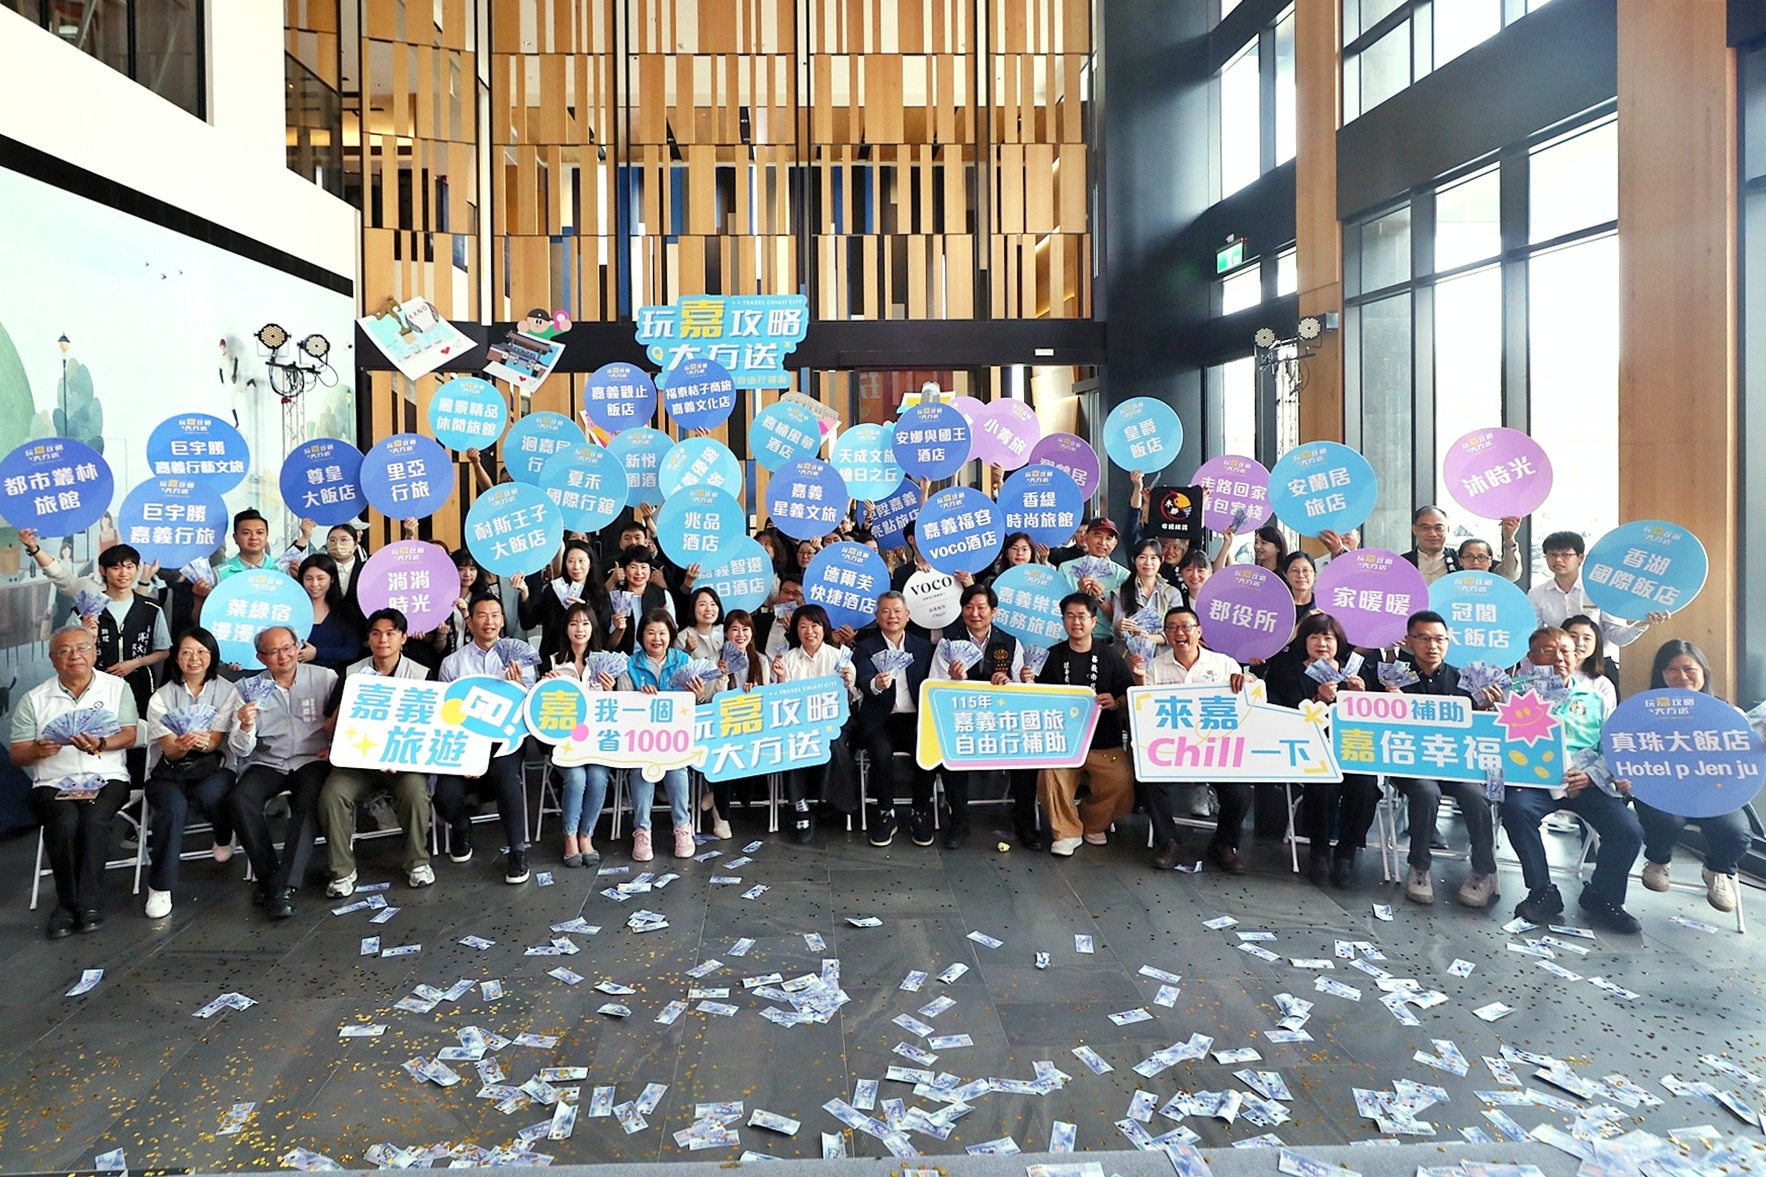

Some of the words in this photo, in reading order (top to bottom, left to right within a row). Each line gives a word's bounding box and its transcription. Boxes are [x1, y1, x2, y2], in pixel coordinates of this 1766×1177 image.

[409, 305, 428, 320] KANO
[640, 300, 802, 339] 玩嘉攻略
[668, 344, 777, 370] 大方送
[592, 385, 648, 400] 嘉義觀止
[666, 380, 732, 400] 福泰桔子商旅
[607, 403, 635, 416] 飯店
[672, 396, 730, 416] 嘉義文化店
[896, 427, 966, 445] 安娜與國王
[984, 418, 1027, 456] 小青旅
[171, 441, 226, 456] 巨宇勝
[766, 436, 794, 460] 酒店
[918, 448, 946, 463] 酒店
[1130, 437, 1164, 460] 飯店
[155, 460, 244, 474] 嘉義行藝文旅
[306, 465, 343, 485] 尊皇
[387, 458, 426, 482] 里亞
[1462, 455, 1536, 498] 沐時光
[390, 480, 431, 502] 行旅
[567, 469, 602, 490] 夏禾
[1288, 467, 1352, 498] 安蘭居
[34, 490, 81, 516] 旅館
[302, 485, 356, 508] 大飯店
[791, 483, 823, 501] 嘉義
[142, 504, 206, 523] 巨宇勝
[773, 500, 838, 522] 星義文旅
[1304, 494, 1346, 518] 旅店
[474, 504, 548, 542] 耐斯王子
[684, 512, 720, 531] 兆品
[922, 508, 993, 541] 嘉義福容
[1006, 512, 1074, 528] 時尚旅館
[130, 526, 215, 546] 嘉義行旅
[490, 530, 547, 561] 大飯店
[682, 532, 720, 552] 酒店
[929, 530, 998, 560] voco酒店
[1624, 548, 1672, 576] 香湖
[700, 578, 765, 598] 日酒店
[1588, 564, 1681, 606] 國際飯店
[226, 598, 292, 622] 葉綠宿
[388, 594, 431, 614] 時光
[810, 583, 876, 615] 快捷酒店
[1333, 586, 1412, 617] 家暖暖
[1209, 598, 1278, 634] 郡役所
[1451, 602, 1497, 622] 冠閣
[349, 683, 438, 725] 嘉義
[538, 690, 580, 731] 嘉
[594, 698, 674, 724] 我一個
[951, 696, 992, 709] 115年
[1154, 694, 1238, 730] 來嘉
[953, 709, 1065, 733] 嘉義市國旅
[379, 726, 470, 768] 旅遊
[596, 729, 690, 752] 省1000
[711, 729, 822, 775] 大方送
[955, 734, 1068, 755] 自由行補助
[1340, 727, 1502, 770] 嘉倍幸福
[1610, 729, 1751, 754] 真珠大飯店
[1616, 760, 1671, 777] Hotel
[1675, 764, 1690, 780] p
[1694, 760, 1732, 776] Jen
[1736, 760, 1759, 779] ju
